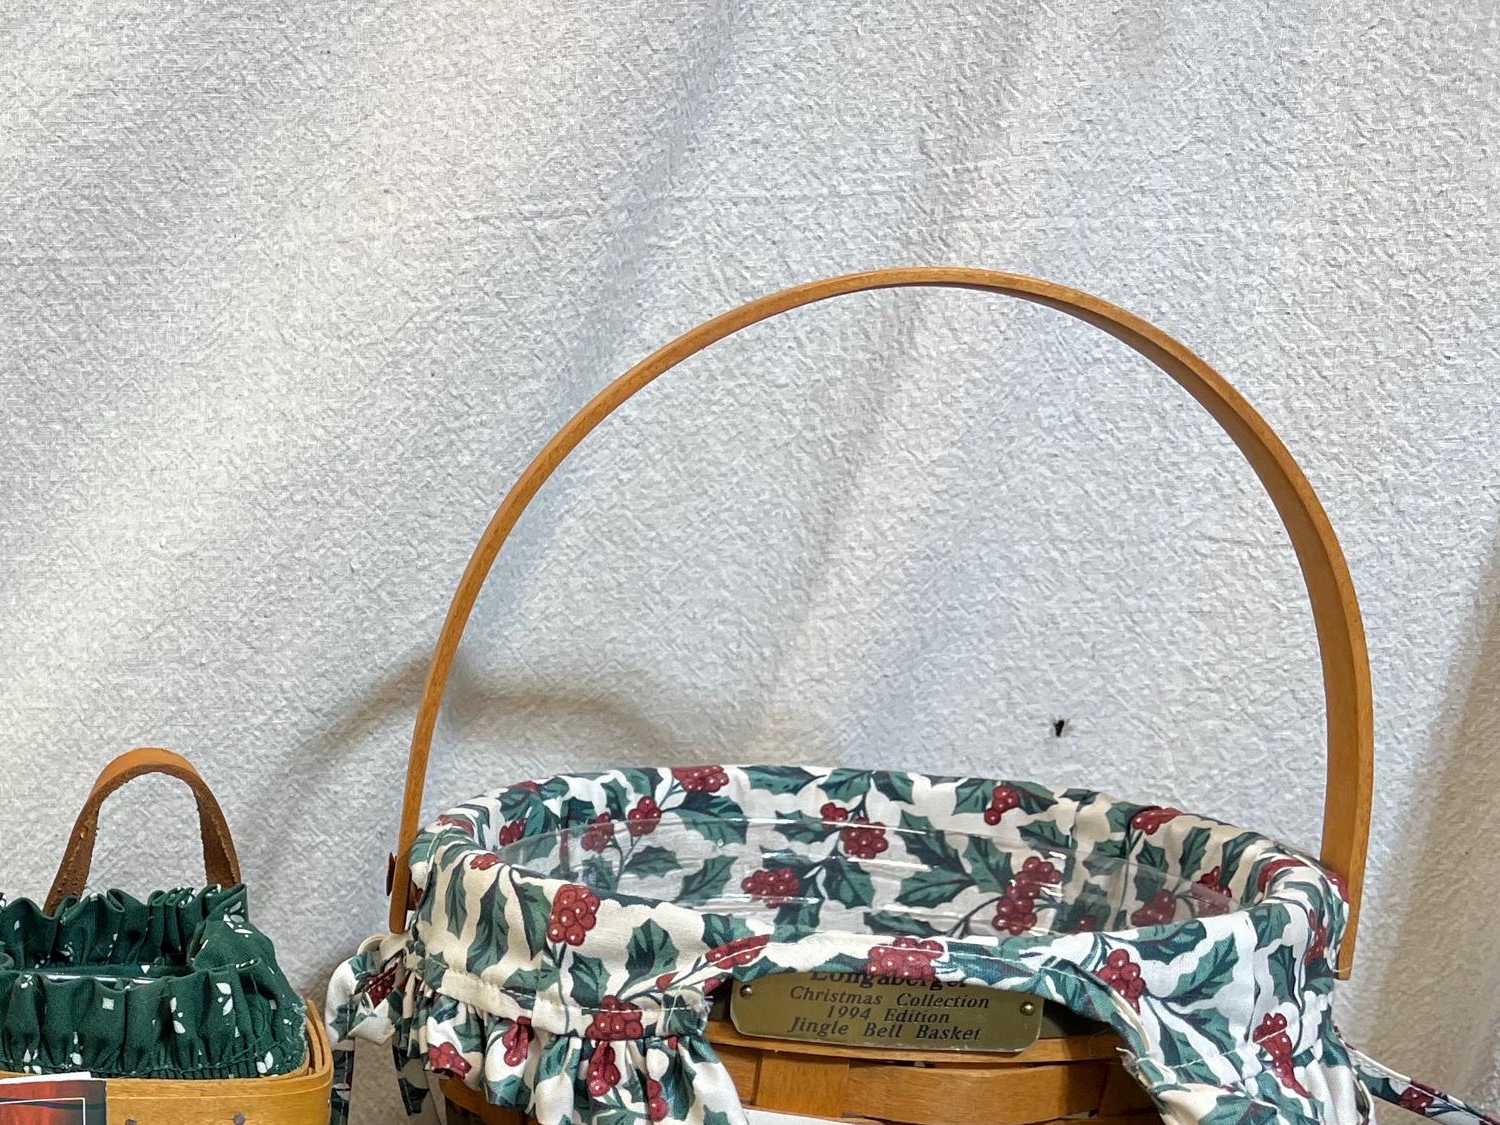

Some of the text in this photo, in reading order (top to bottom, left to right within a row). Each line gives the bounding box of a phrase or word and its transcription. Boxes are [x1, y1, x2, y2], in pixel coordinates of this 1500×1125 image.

[790, 985, 990, 1009] Christmas Collection
[827, 1004, 950, 1024] 1994 Edition
[789, 1016, 981, 1041] Jingle Bell Basket
